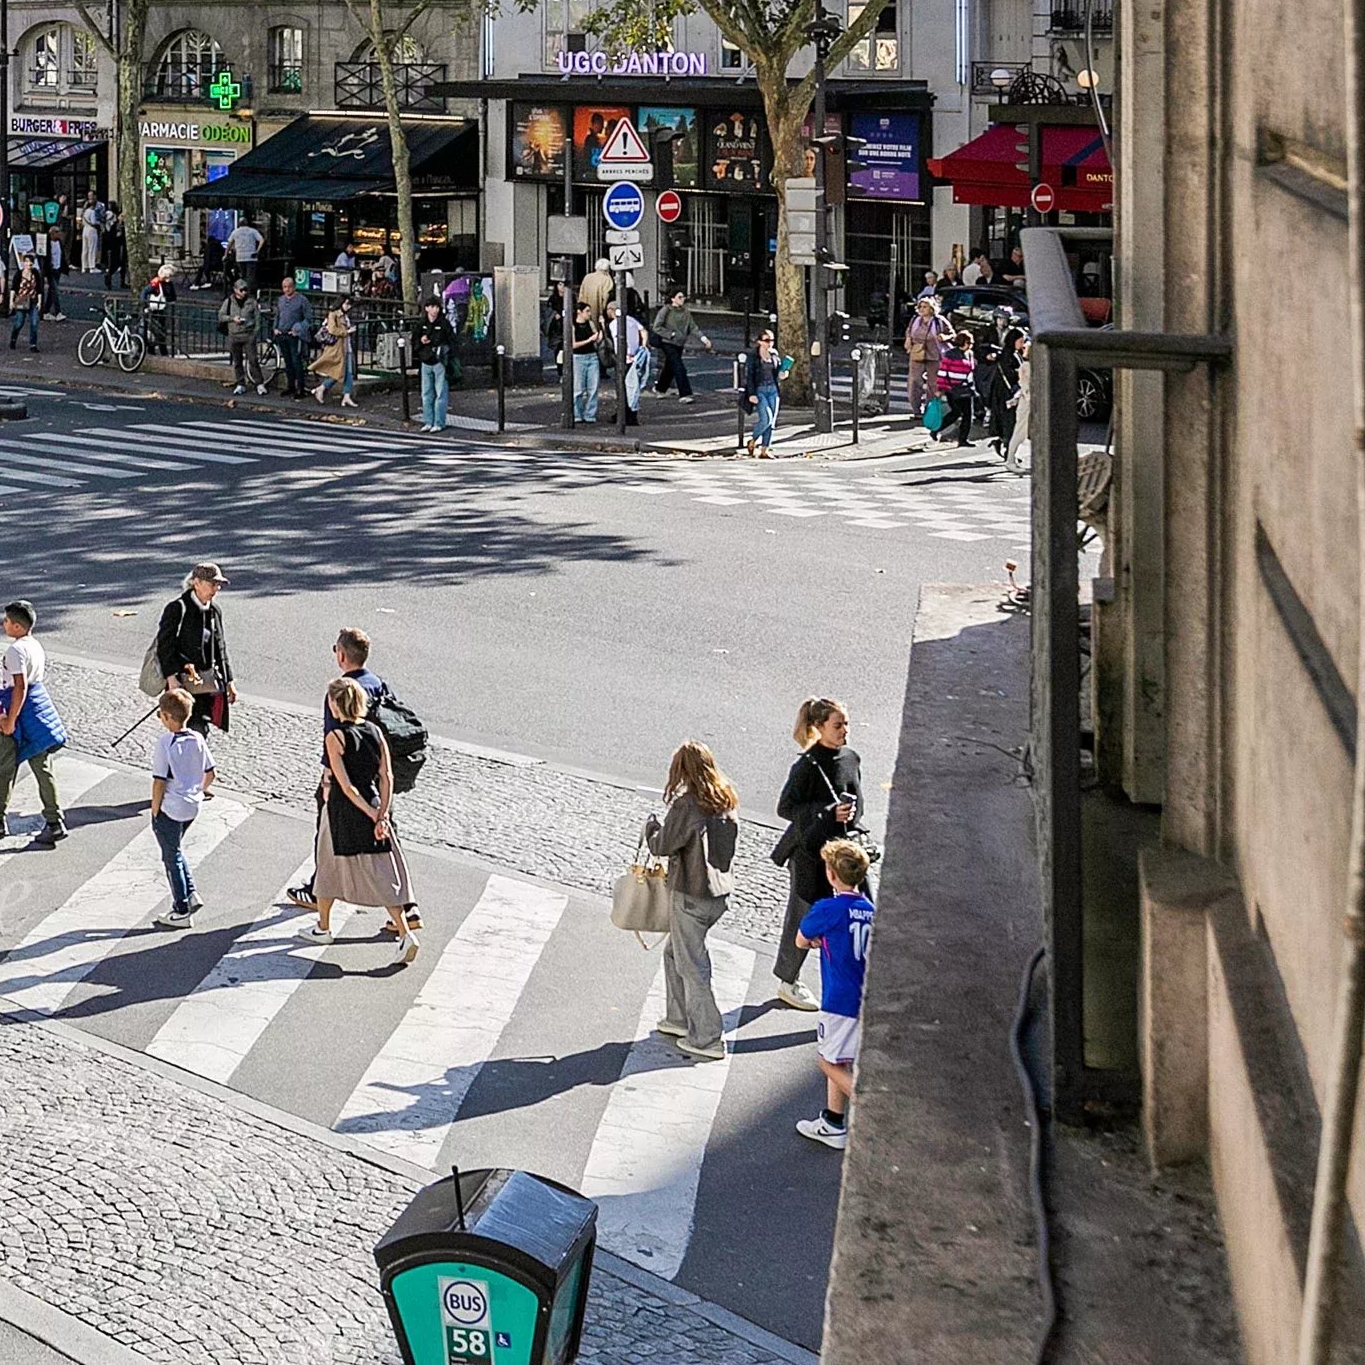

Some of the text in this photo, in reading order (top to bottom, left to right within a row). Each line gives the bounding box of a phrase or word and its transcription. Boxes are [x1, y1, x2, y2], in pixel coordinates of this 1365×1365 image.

[558, 50, 607, 73] UGC
[11, 118, 53, 133] BURGER
[138, 122, 251, 143] ARMACIE ODÉON
[449, 1293, 482, 1312] BUS
[452, 1329, 487, 1356] 58
